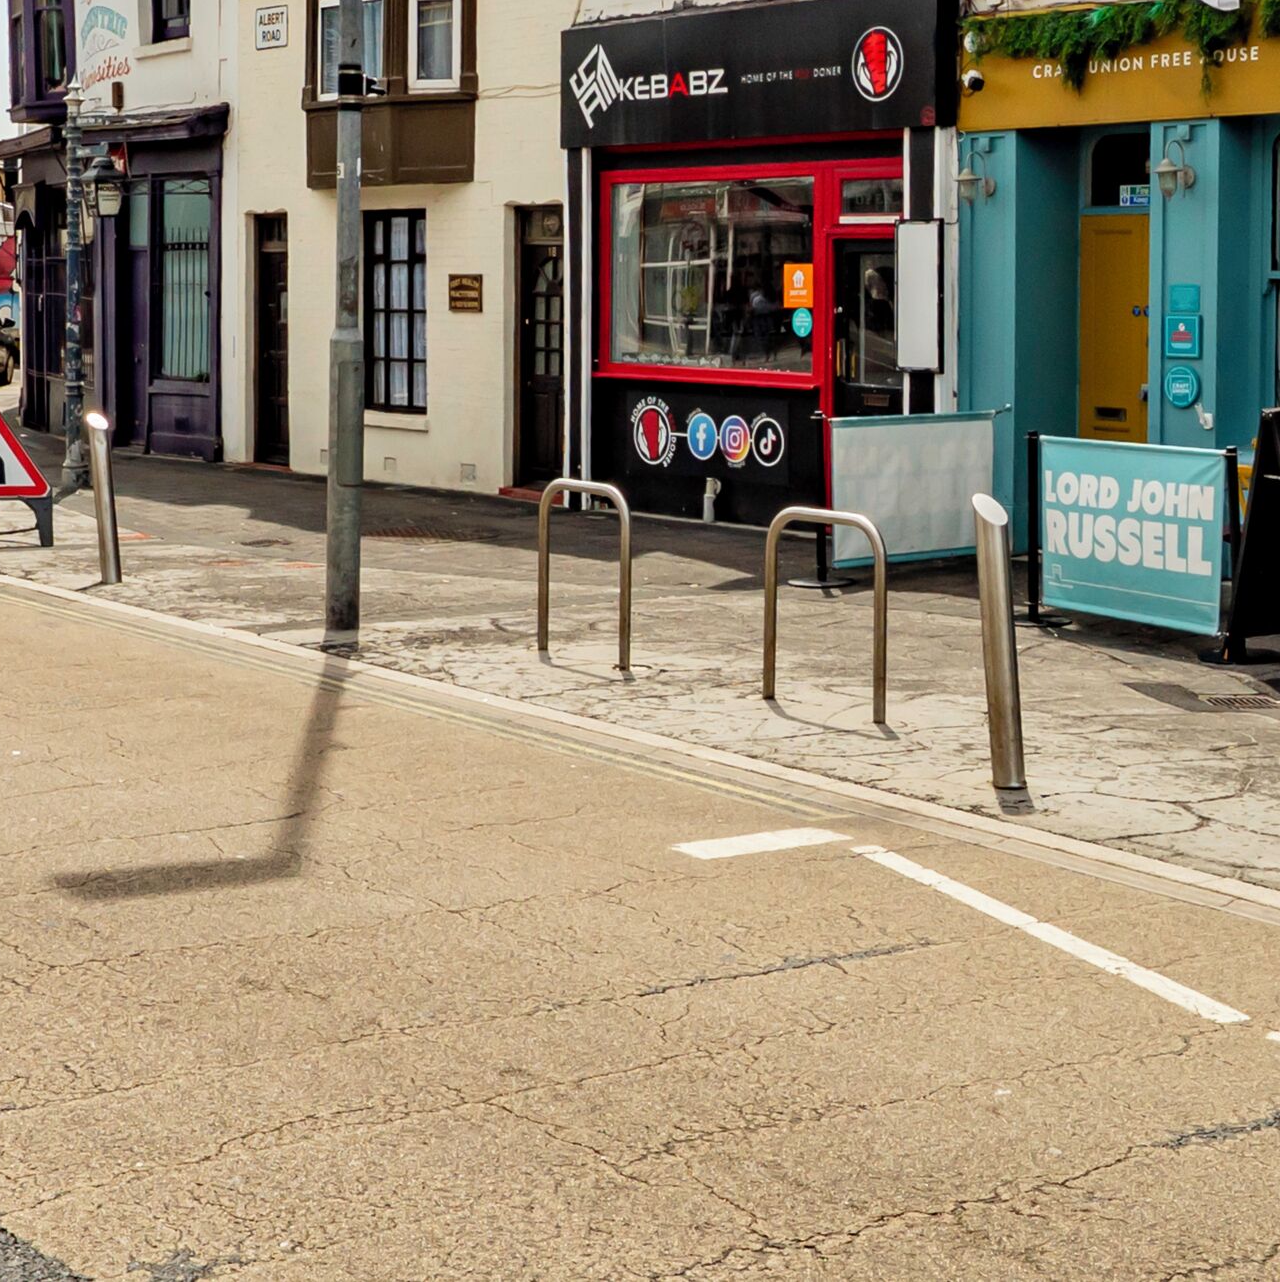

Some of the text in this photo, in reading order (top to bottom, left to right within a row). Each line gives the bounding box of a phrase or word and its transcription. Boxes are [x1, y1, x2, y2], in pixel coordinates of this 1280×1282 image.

[259, 11, 285, 26] ALBERT
[262, 29, 281, 42] ROAD
[1088, 56, 1144, 74] UNION
[1150, 51, 1192, 68] FREE
[1199, 45, 1259, 65] OUSE
[620, 68, 729, 102] KEBABZ
[740, 72, 764, 84] HOME
[766, 71, 777, 82] OF
[779, 69, 793, 80] THE
[813, 65, 841, 78] DONER
[647, 396, 656, 405] OF
[657, 398, 670, 413] THE
[630, 401, 646, 423] HOME
[663, 436, 678, 468] DONER
[1044, 470, 1215, 521] LORD JOHN
[1046, 508, 1212, 577] RUSSELL
